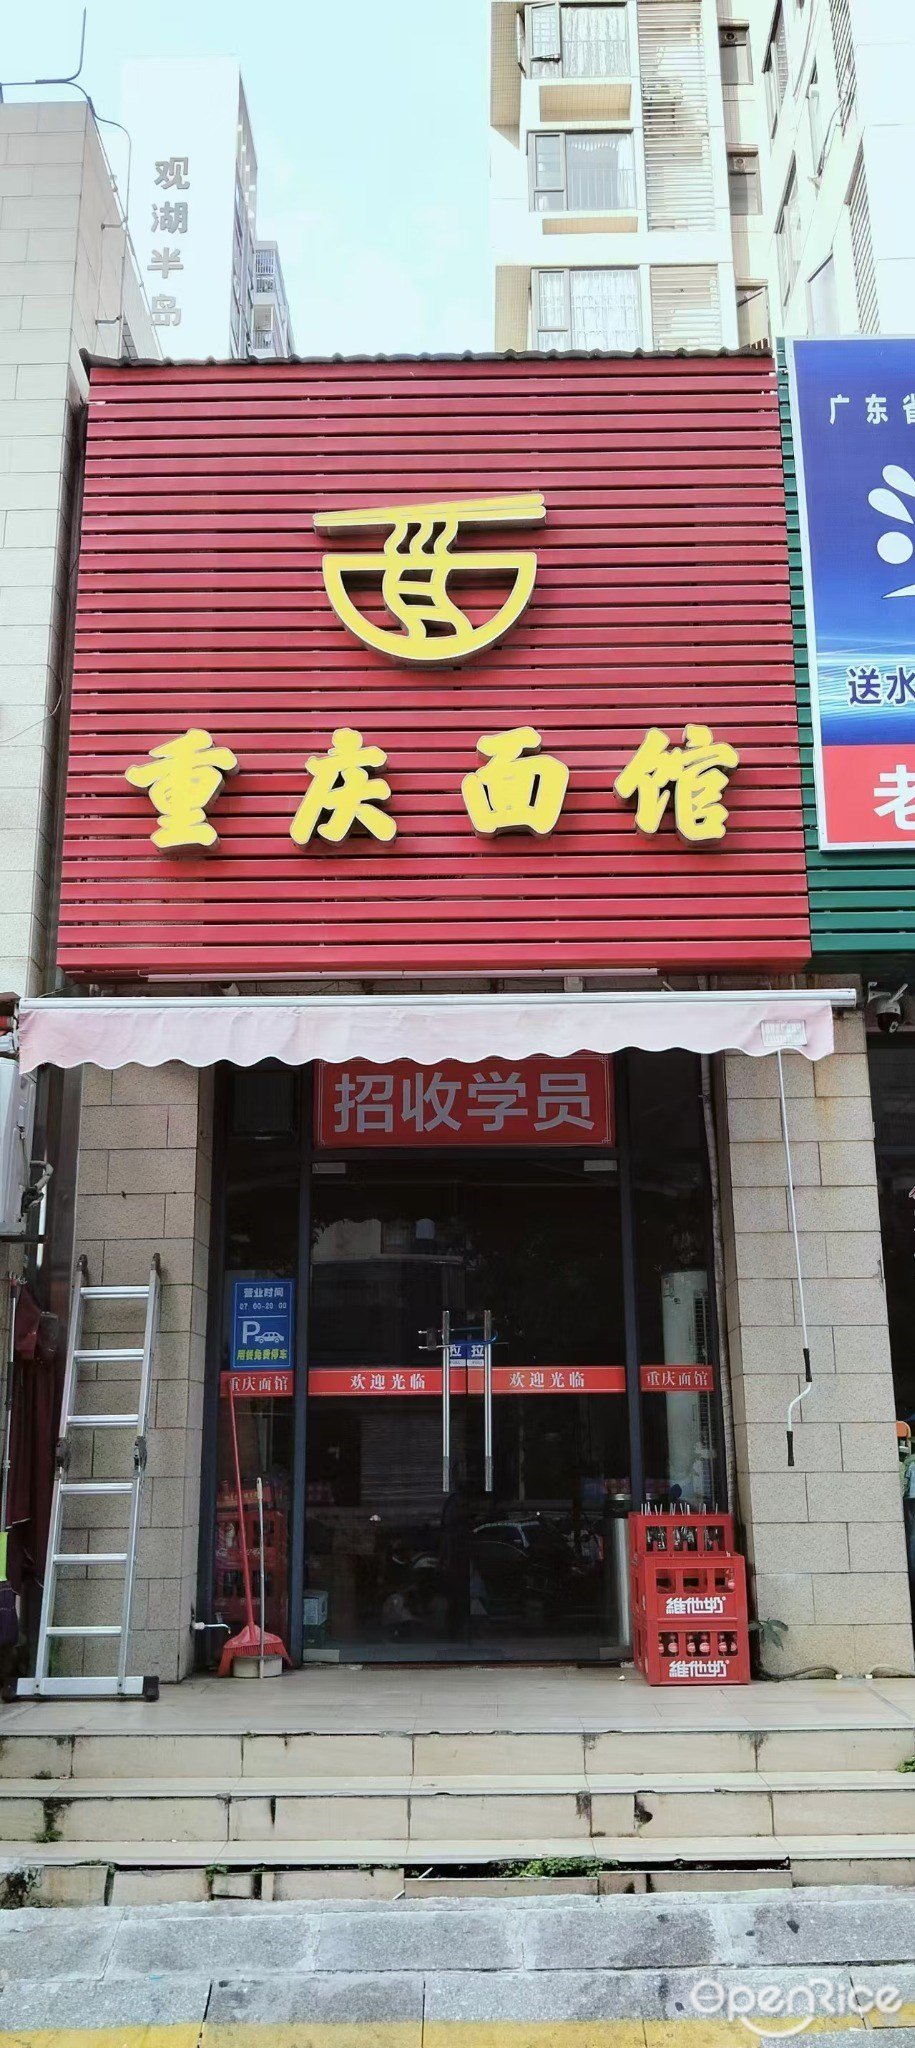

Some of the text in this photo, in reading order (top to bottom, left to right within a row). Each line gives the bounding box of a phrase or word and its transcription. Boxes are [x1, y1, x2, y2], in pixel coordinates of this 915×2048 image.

[147, 156, 190, 327] 观湖半岛
[124, 723, 740, 851] 重庆面馆
[334, 1072, 595, 1132] 招收学员
[243, 1287, 285, 1298] 营业时间
[242, 1320, 261, 1344] P
[471, 1344, 485, 1357] 拉
[230, 1376, 289, 1392] 重庆面馆
[350, 1373, 426, 1390] 欢迎光临
[509, 1371, 585, 1388] 欢迎光临
[646, 1370, 709, 1387] 重庆面馆
[666, 1597, 724, 1614] 維他奶
[669, 1660, 727, 1677] 維他奶
